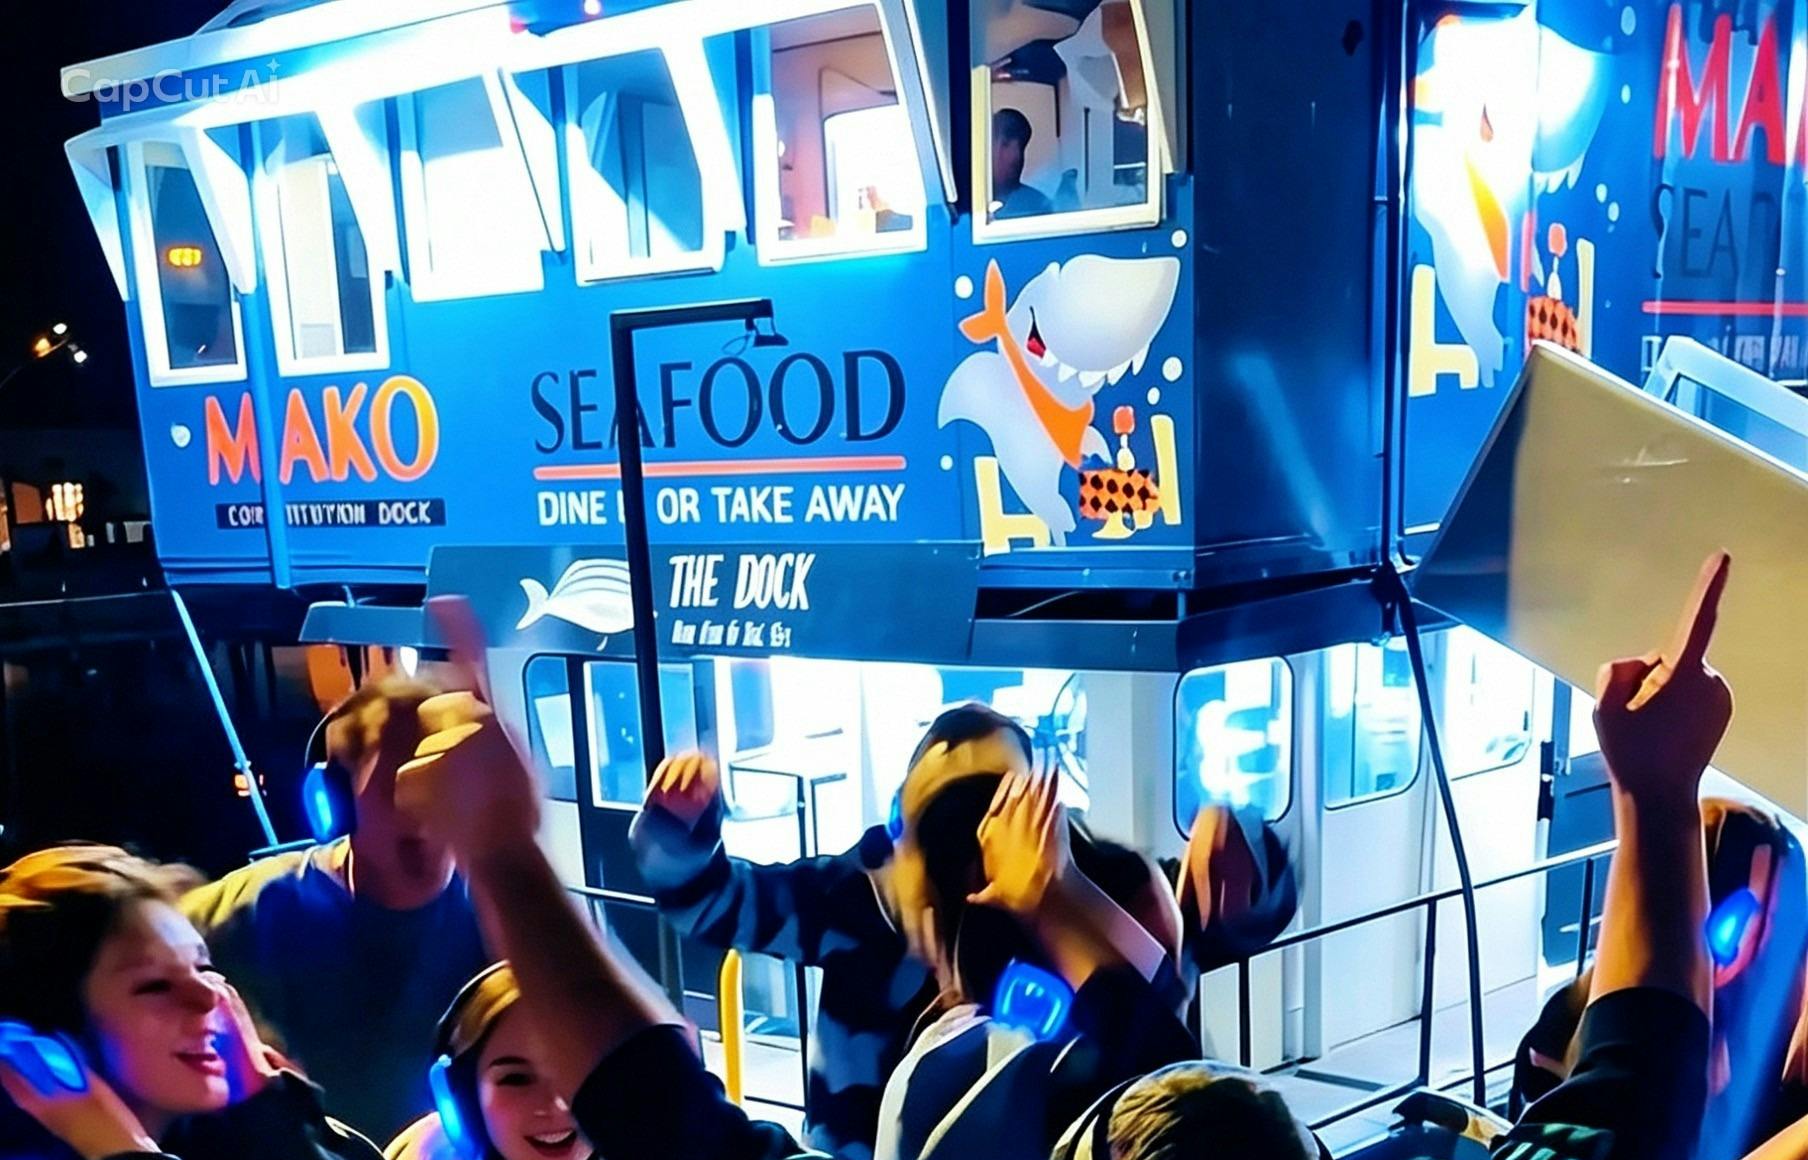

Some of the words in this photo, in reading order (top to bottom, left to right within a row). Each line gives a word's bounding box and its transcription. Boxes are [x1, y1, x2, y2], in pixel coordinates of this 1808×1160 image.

[1653, 3, 1808, 168] MA
[205, 375, 440, 486] MAKO
[378, 500, 432, 525] DOCK
[537, 489, 607, 526] DINE
[656, 487, 700, 525] OR
[711, 486, 794, 523] TAKE
[804, 483, 905, 522] AWAY
[668, 553, 725, 608] THE
[733, 552, 816, 611] DOCK
